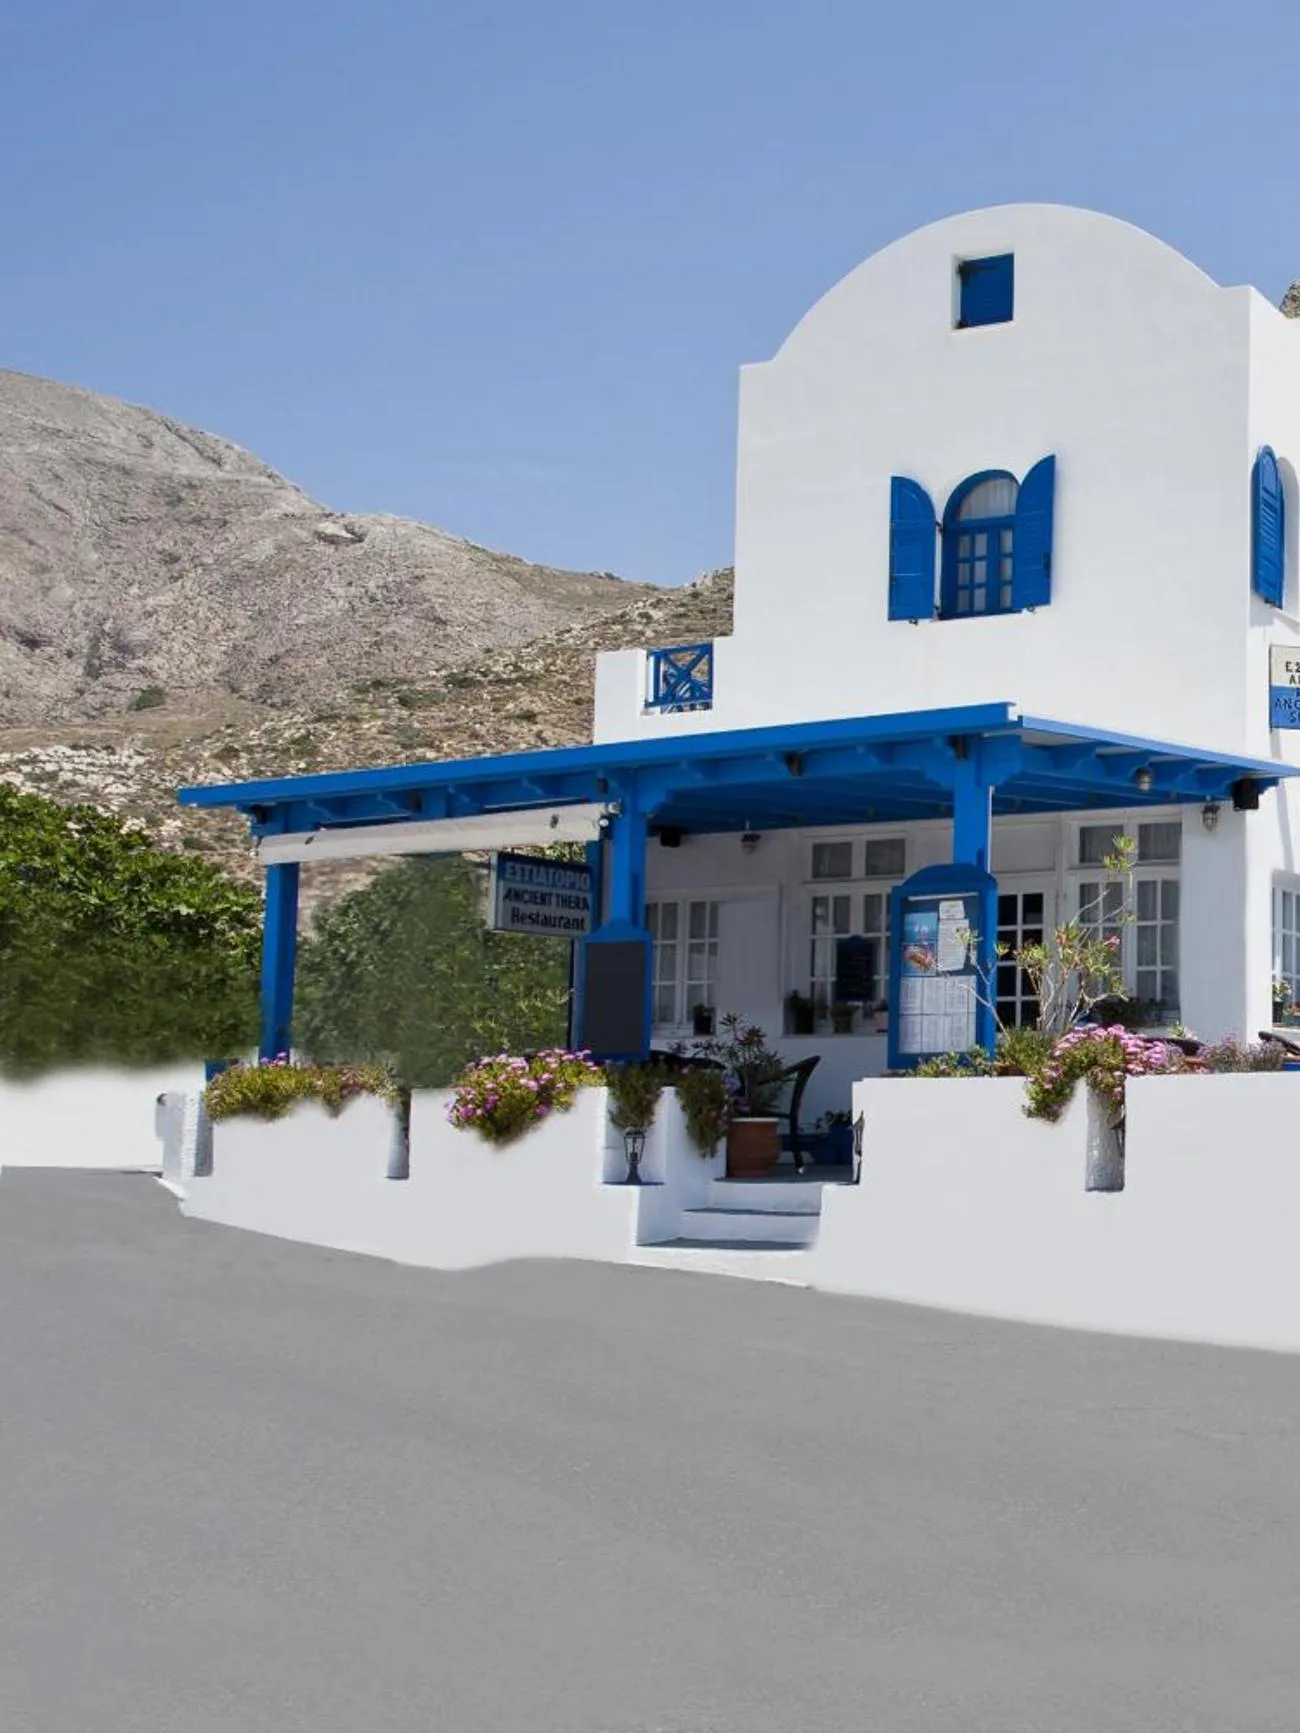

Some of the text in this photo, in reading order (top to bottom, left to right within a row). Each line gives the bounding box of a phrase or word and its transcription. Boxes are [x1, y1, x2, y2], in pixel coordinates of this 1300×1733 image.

[505, 861, 590, 890] ΕΣΤΙΑΤΟΡΙΟ
[503, 887, 590, 911] ANCIENT THERA
[510, 906, 586, 930] Restaurant
